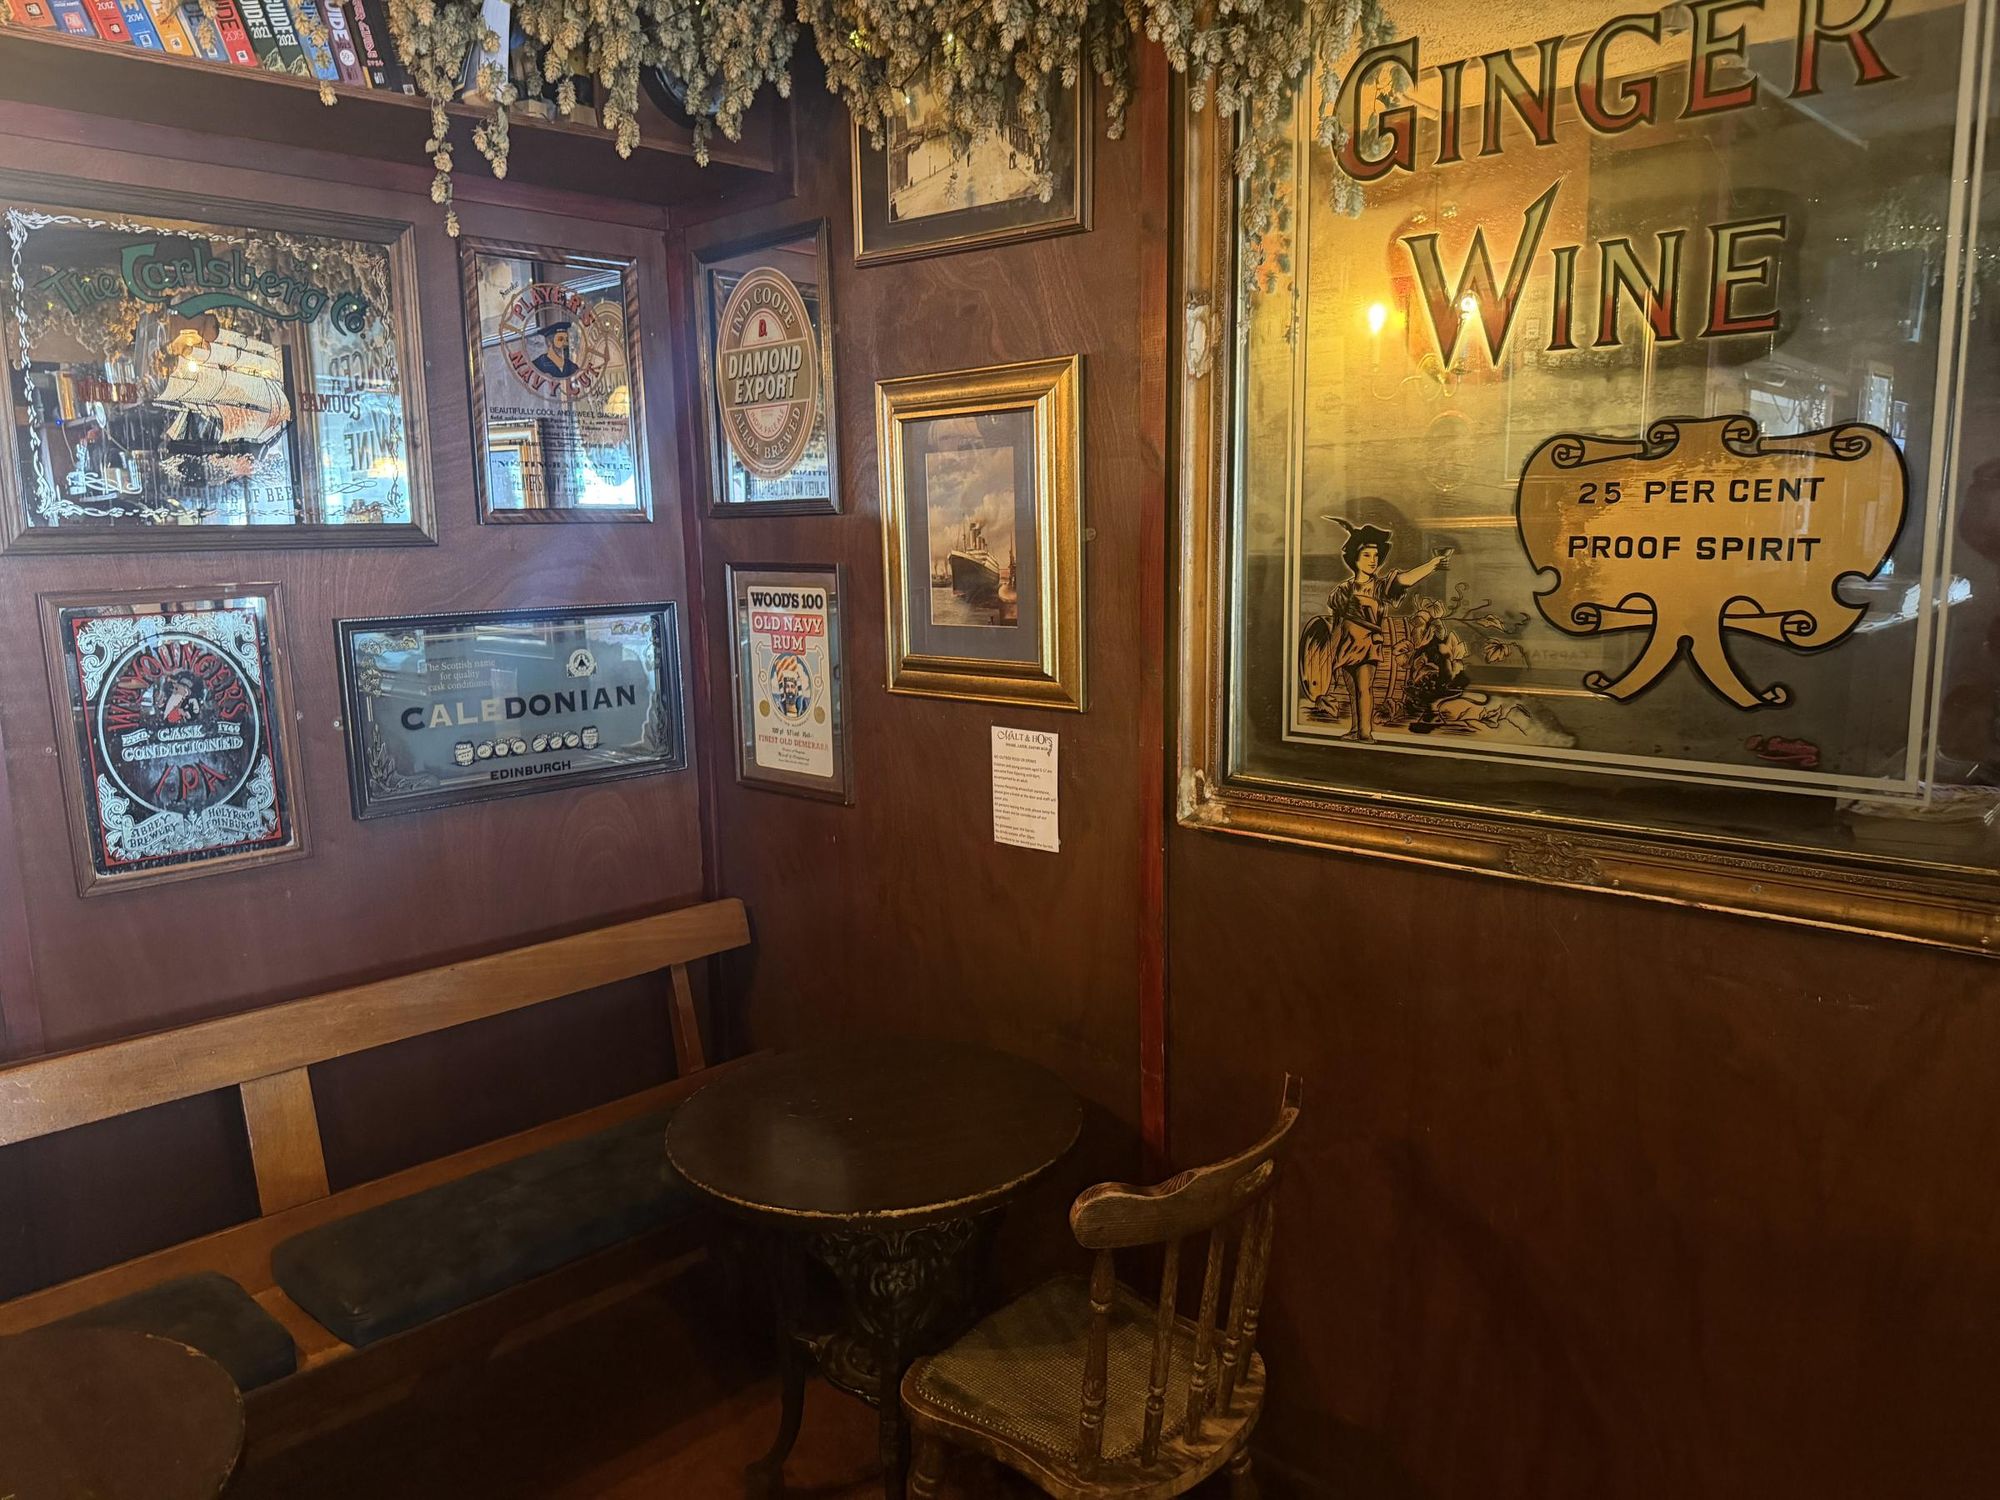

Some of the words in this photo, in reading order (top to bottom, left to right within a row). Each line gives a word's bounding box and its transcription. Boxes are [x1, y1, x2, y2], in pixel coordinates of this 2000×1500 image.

[250, 26, 273, 39] 2021
[276, 34, 298, 47] 2021
[1333, 0, 1900, 183] GINGER
[34, 266, 119, 315] The
[121, 242, 328, 322] Carlsberg
[1401, 173, 1788, 372] WINE
[731, 299, 751, 337] IND
[753, 287, 795, 329] COOPE
[509, 350, 561, 397] NAVY
[566, 363, 600, 396] CUT
[728, 345, 804, 381] DIAMOND
[735, 372, 799, 405] EXPORT
[490, 406, 534, 415] BEAUTIFULLY
[734, 413, 760, 455] ALLOA
[764, 407, 801, 459] BREWED
[1578, 481, 1622, 504] 25
[1645, 480, 1715, 504] PER
[1728, 477, 1825, 503] CENT
[1568, 535, 1681, 559] PROOF
[1696, 536, 1821, 562] SPIRIT
[751, 592, 799, 608] WOOD'S
[801, 594, 823, 609] 100
[754, 615, 781, 631] OLD
[783, 616, 822, 634] NAVY
[772, 634, 804, 652] RUM
[440, 671, 452, 681] for
[453, 669, 480, 681] quality
[441, 659, 473, 671] Scottish
[401, 685, 636, 731] CALEDONIAN
[158, 723, 206, 742] CASK
[121, 736, 244, 762] CONDITIONED
[154, 763, 230, 800] IPA
[490, 759, 572, 781] EDINBURGH
[205, 818, 259, 831] EDINBURGH
[208, 808, 255, 820] HOLYROOD
[128, 823, 179, 848] BREWERY
